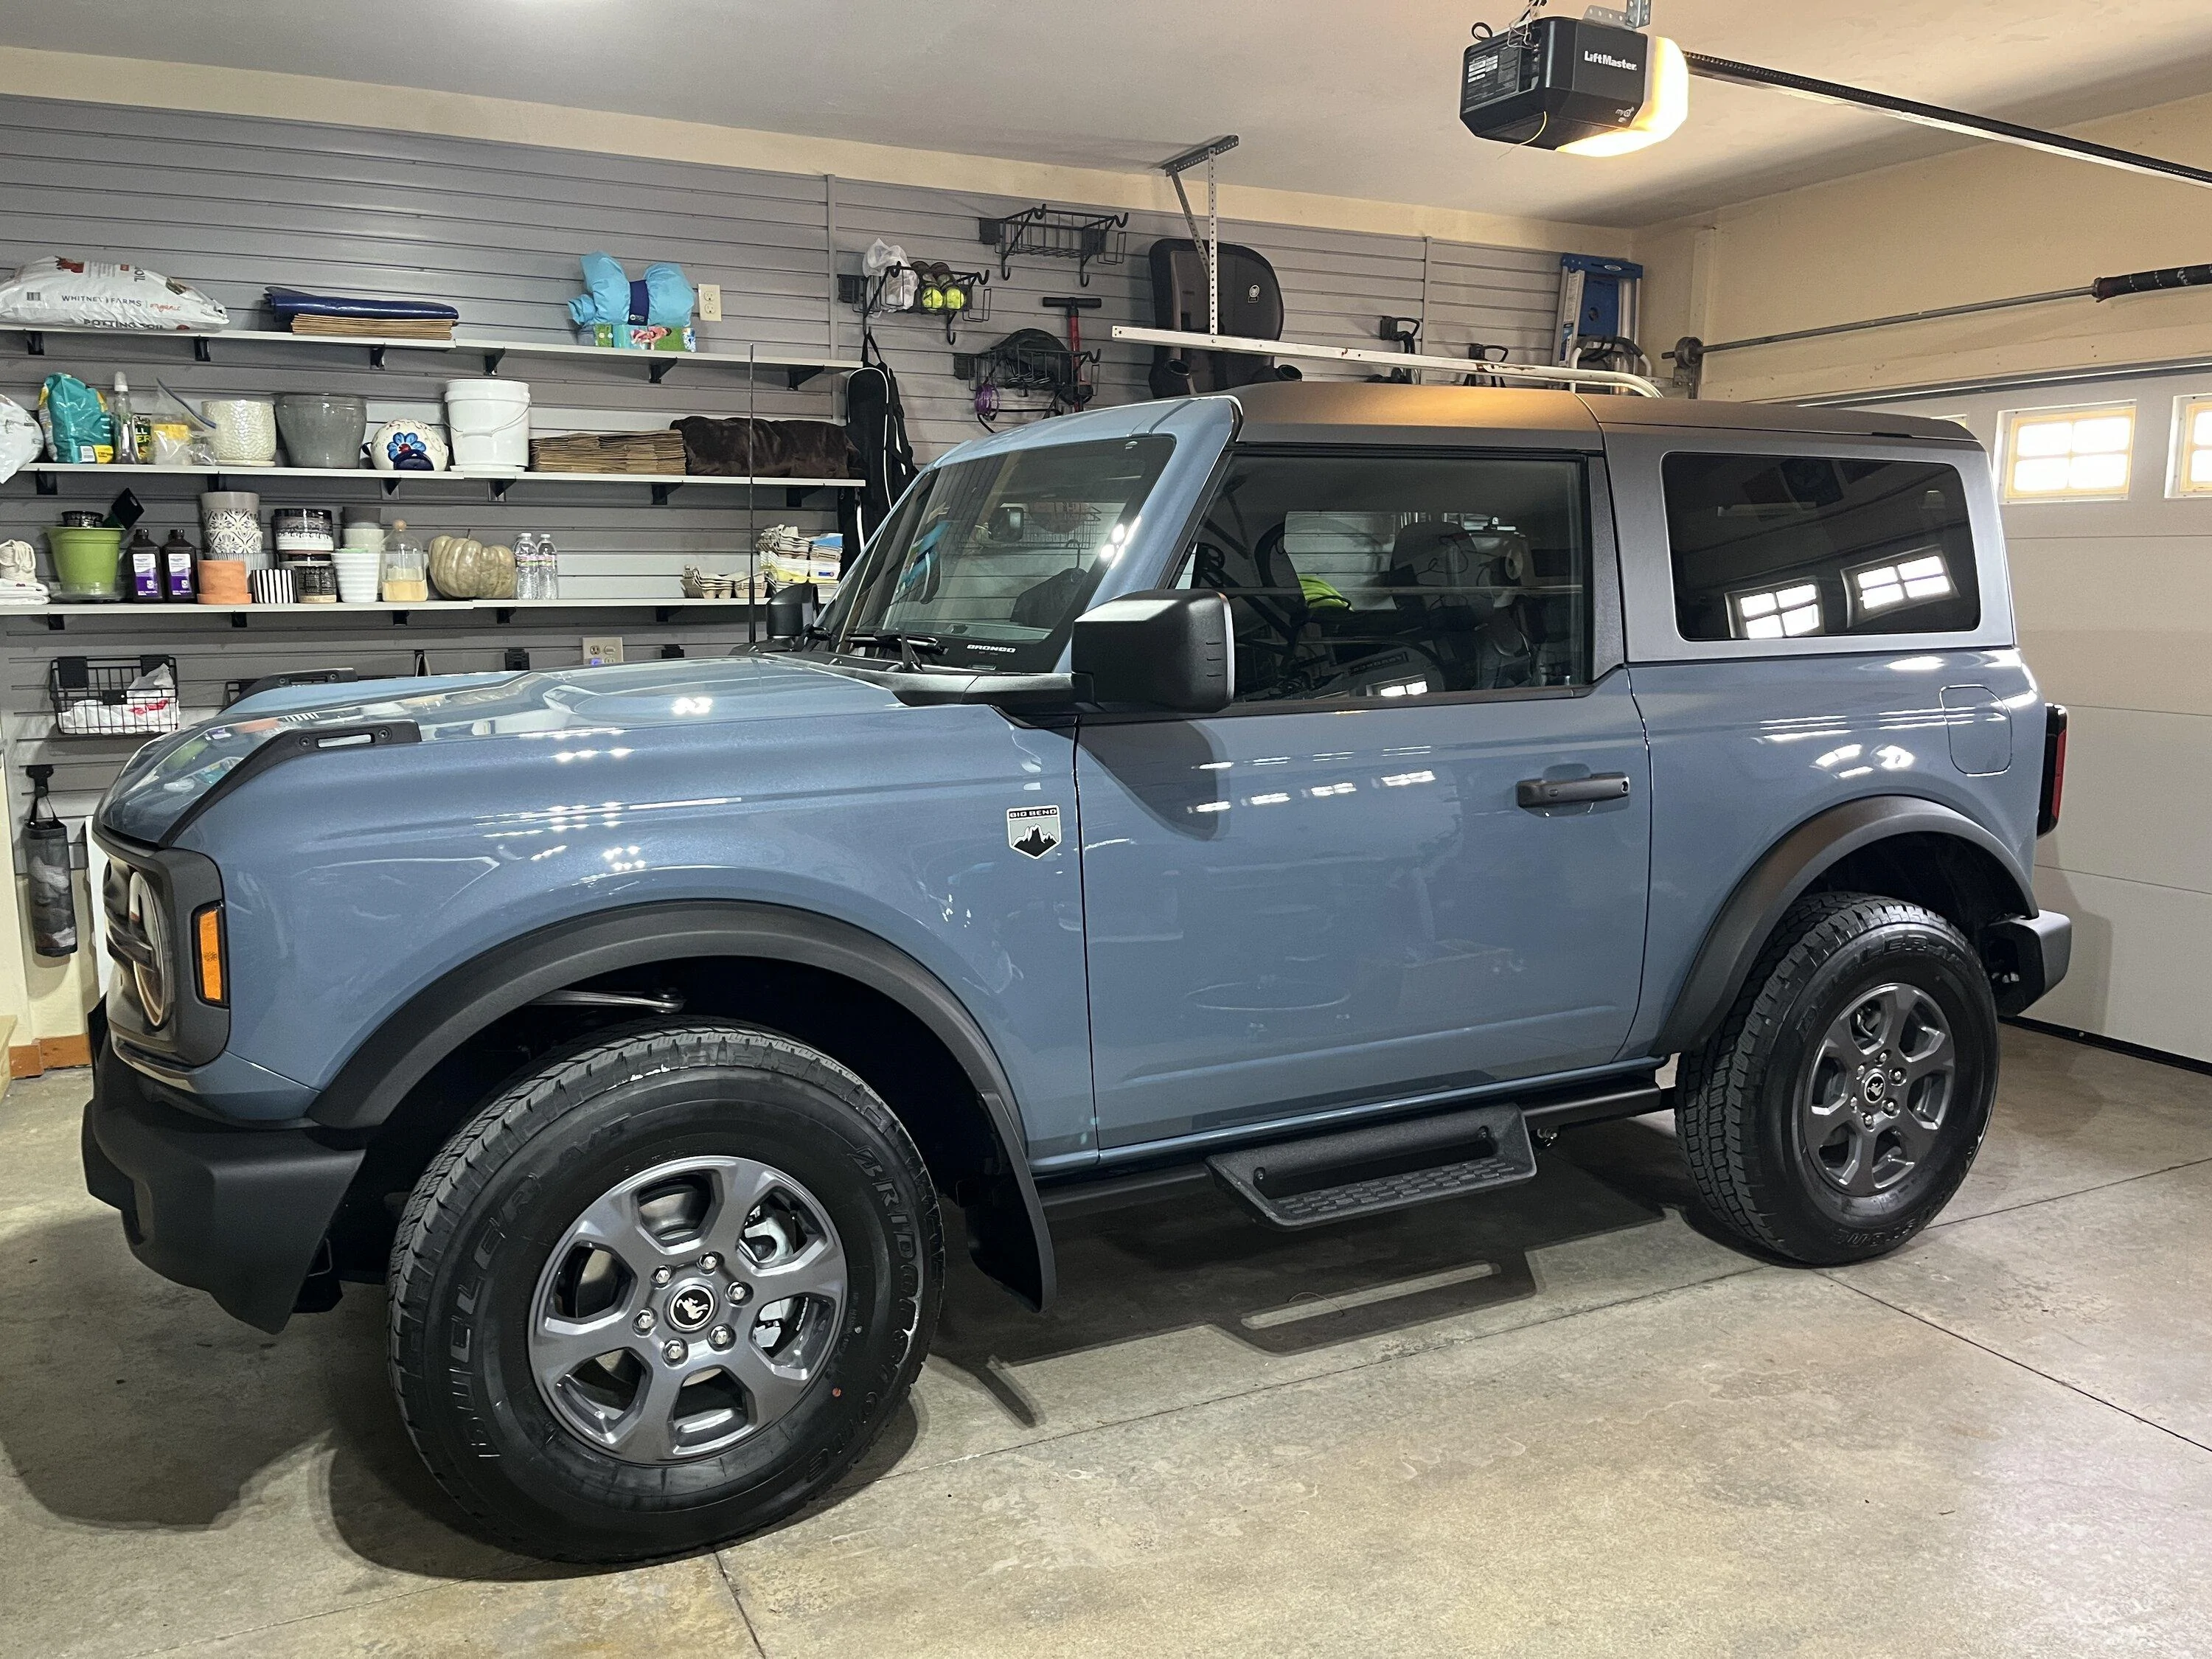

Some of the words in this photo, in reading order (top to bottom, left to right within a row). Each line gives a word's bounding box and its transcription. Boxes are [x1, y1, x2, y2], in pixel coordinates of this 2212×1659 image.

[1584, 50, 1638, 71] LiftMaster
[111, 297, 142, 307] FARMS
[83, 318, 138, 329] POTTING
[967, 644, 1016, 653] BRONCO
[1029, 808, 1057, 817] BEND
